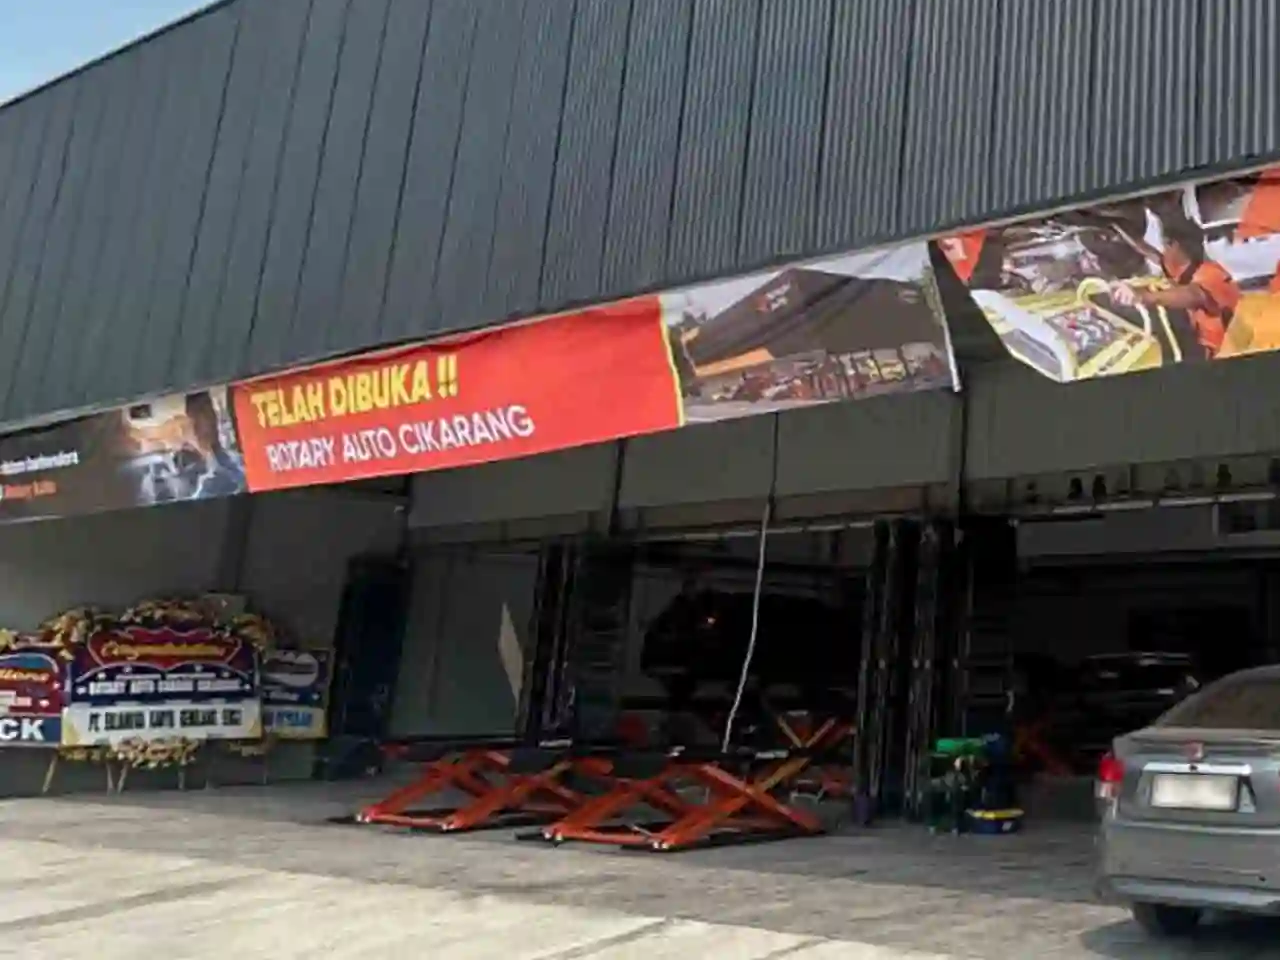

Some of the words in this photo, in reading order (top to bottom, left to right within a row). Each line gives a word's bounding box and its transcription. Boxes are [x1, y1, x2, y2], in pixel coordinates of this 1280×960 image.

[251, 379, 326, 429] TELAH
[328, 359, 432, 417] DIBUKA
[265, 433, 337, 472] ROTARY
[342, 429, 397, 465] AUTO
[399, 403, 536, 454] CIKARANG
